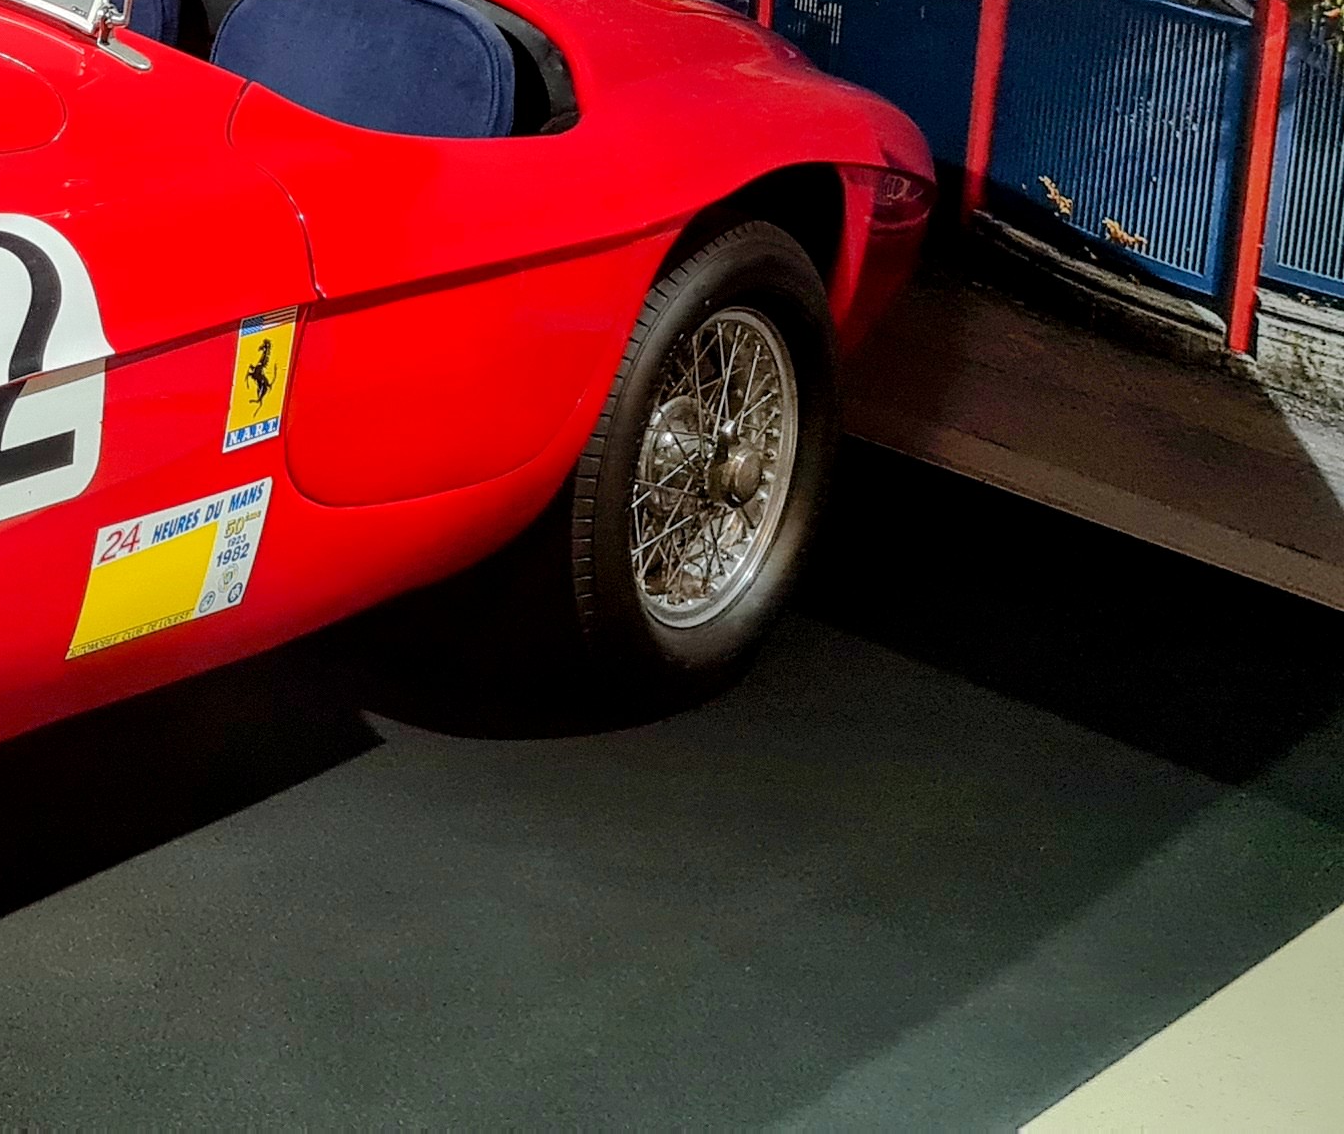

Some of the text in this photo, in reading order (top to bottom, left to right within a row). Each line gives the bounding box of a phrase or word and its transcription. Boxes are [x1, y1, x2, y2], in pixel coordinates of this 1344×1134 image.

[98, 481, 265, 565] 24 HEURES DU MANS
[216, 542, 251, 568] 1982
